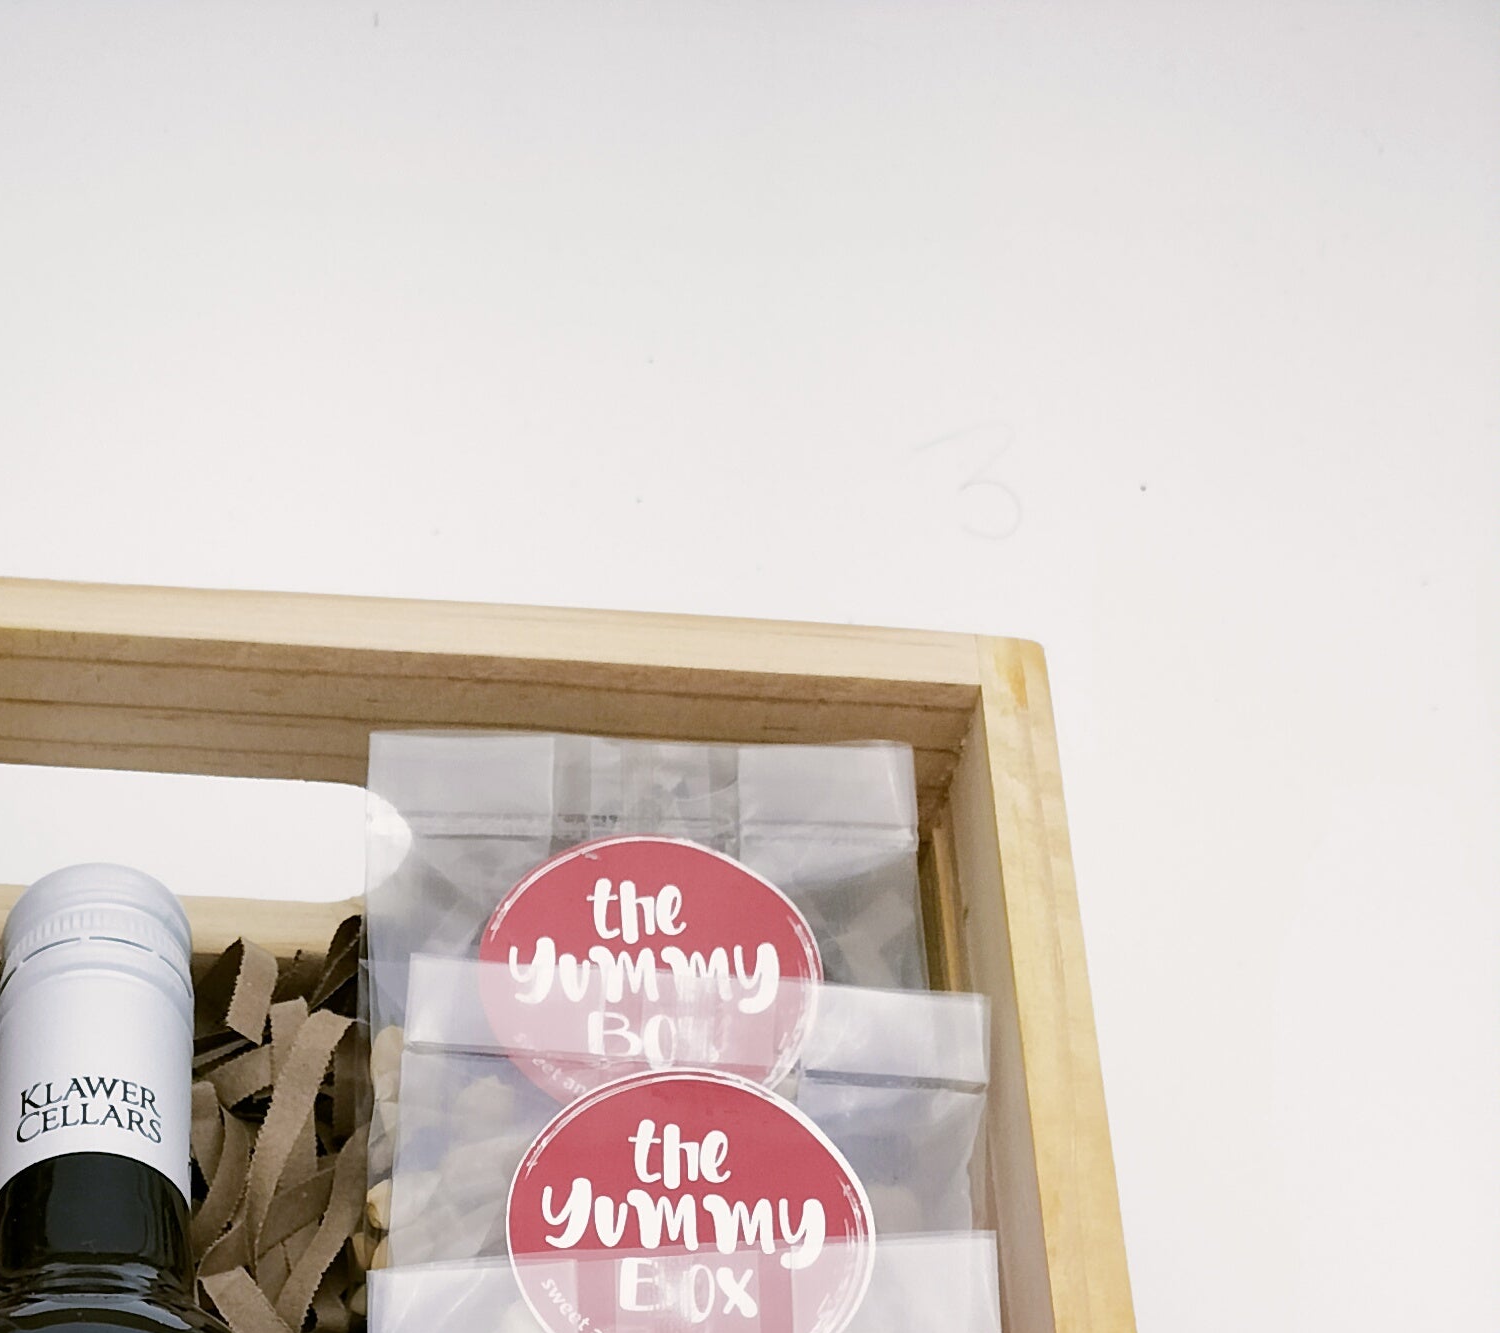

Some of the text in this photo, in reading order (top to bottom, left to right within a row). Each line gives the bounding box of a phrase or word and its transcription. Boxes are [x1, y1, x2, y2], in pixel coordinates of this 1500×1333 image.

[586, 877, 687, 945] the
[19, 1075, 161, 1119] KLAWER
[562, 1076, 588, 1096] an
[15, 1102, 162, 1145] CELLARS
[627, 1118, 732, 1190] the
[541, 1177, 826, 1270] yummy
[541, 1277, 590, 1332] sweet
